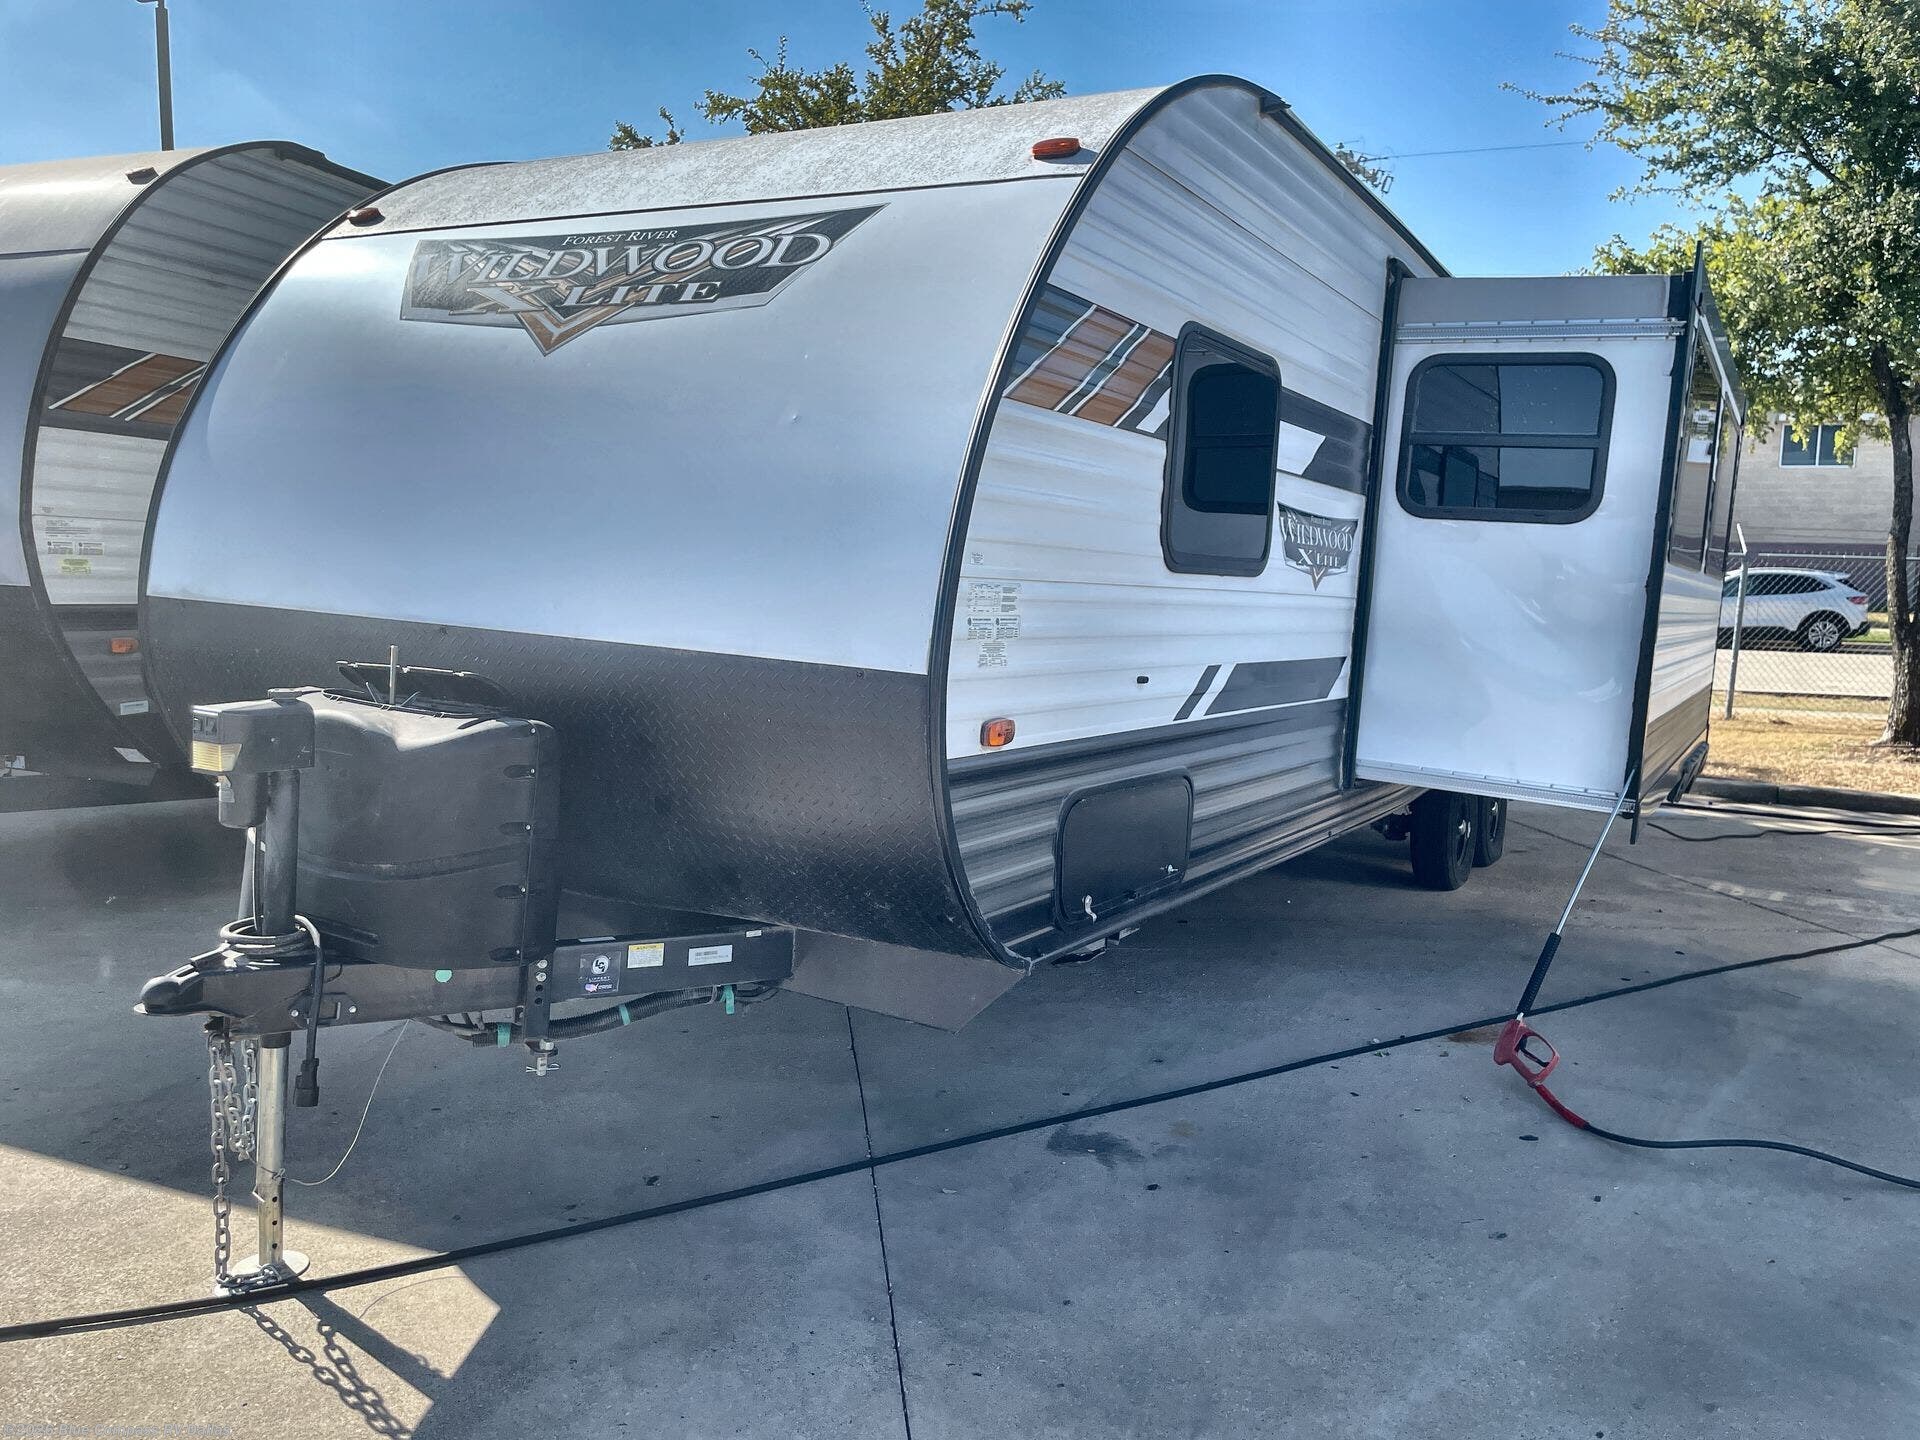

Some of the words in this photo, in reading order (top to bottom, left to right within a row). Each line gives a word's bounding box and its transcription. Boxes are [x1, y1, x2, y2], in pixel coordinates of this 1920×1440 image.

[562, 232, 627, 246] FOREST
[626, 229, 679, 242] RIVER
[411, 231, 833, 285] WILDWOOD
[559, 280, 722, 309] LITE
[1279, 516, 1354, 552] WILDWOOD
[1297, 548, 1313, 566] X
